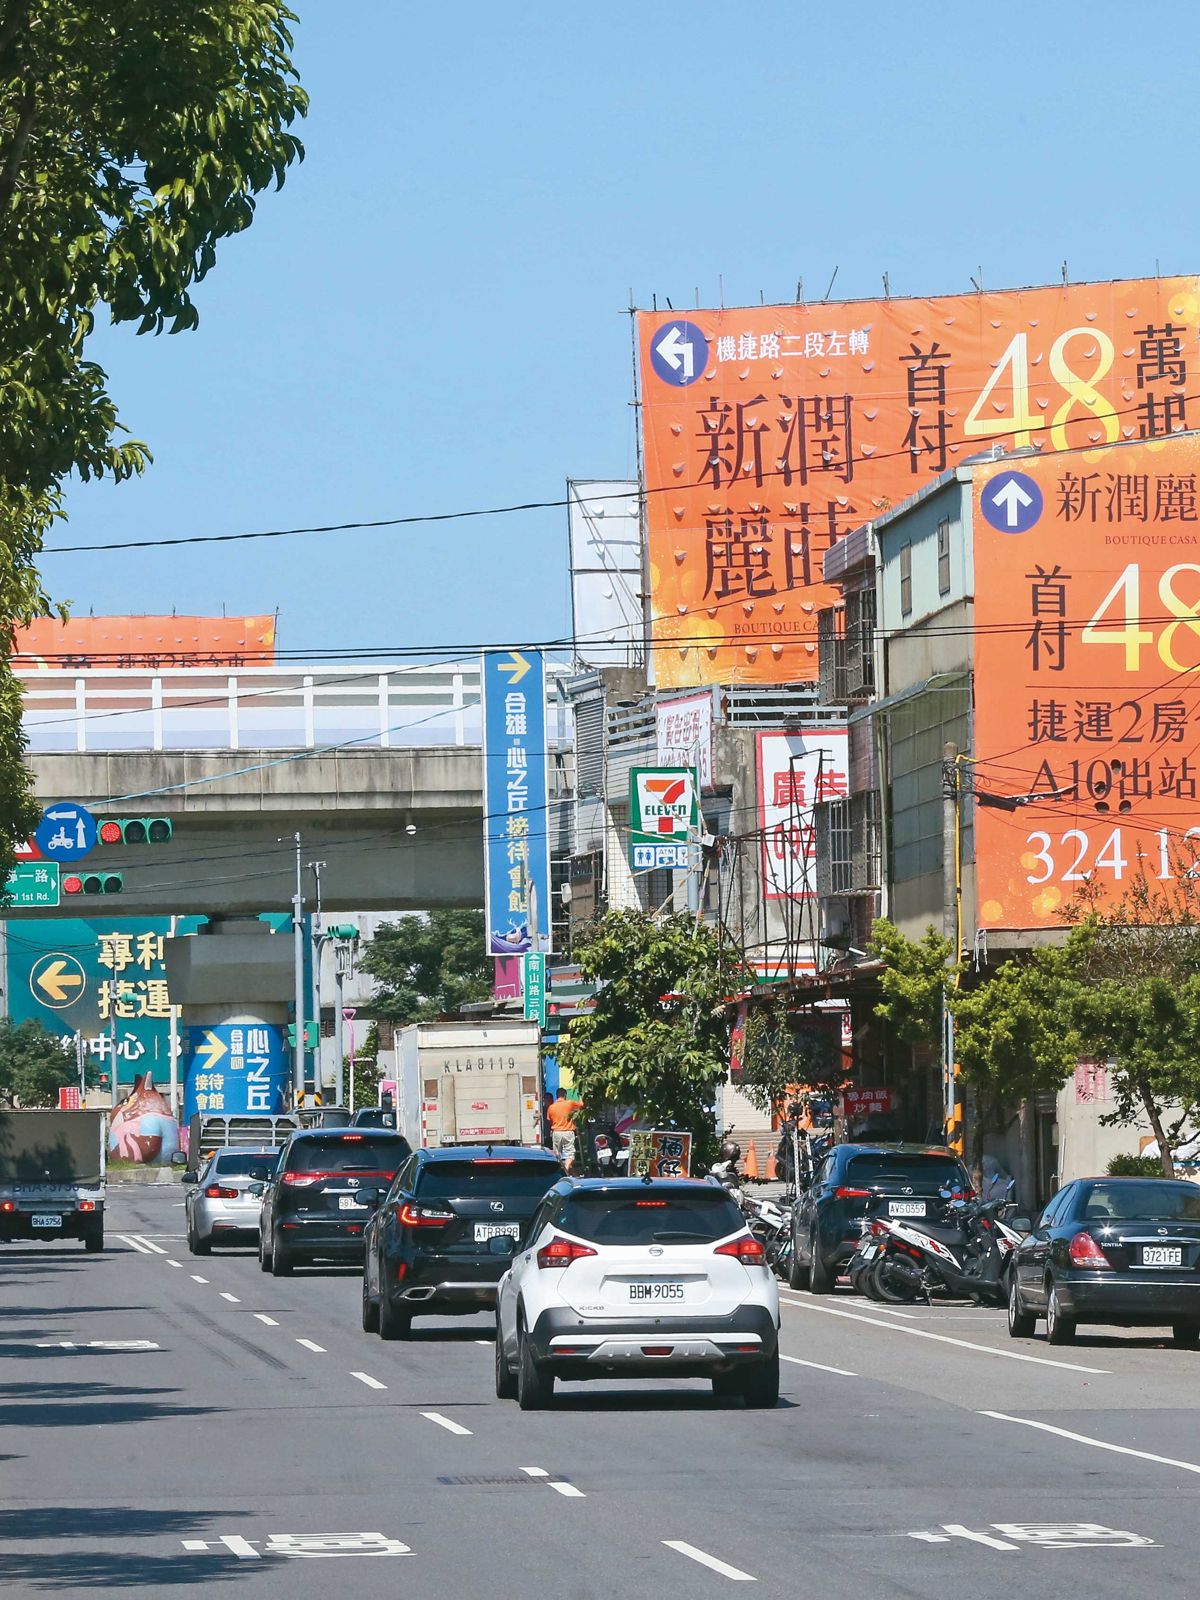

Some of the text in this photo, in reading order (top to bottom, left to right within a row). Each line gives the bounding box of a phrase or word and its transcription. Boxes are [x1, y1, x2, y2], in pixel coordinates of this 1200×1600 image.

[716, 329, 870, 362] 機捷路二段左轉
[898, 342, 953, 474] 首付
[964, 327, 1120, 450] 48
[695, 393, 854, 489] 新潤
[1105, 534, 1198, 547] BOUTIQUE CASA
[1024, 564, 1072, 672] 首付
[734, 622, 800, 634] BOUTIQUE
[22, 893, 33, 901] 1st
[36, 893, 50, 901] Rd.
[246, 1028, 271, 1110] 心之丘
[444, 1057, 516, 1073] KLA8119
[195, 1073, 225, 1091] 接待
[196, 1093, 225, 1110] 會館
